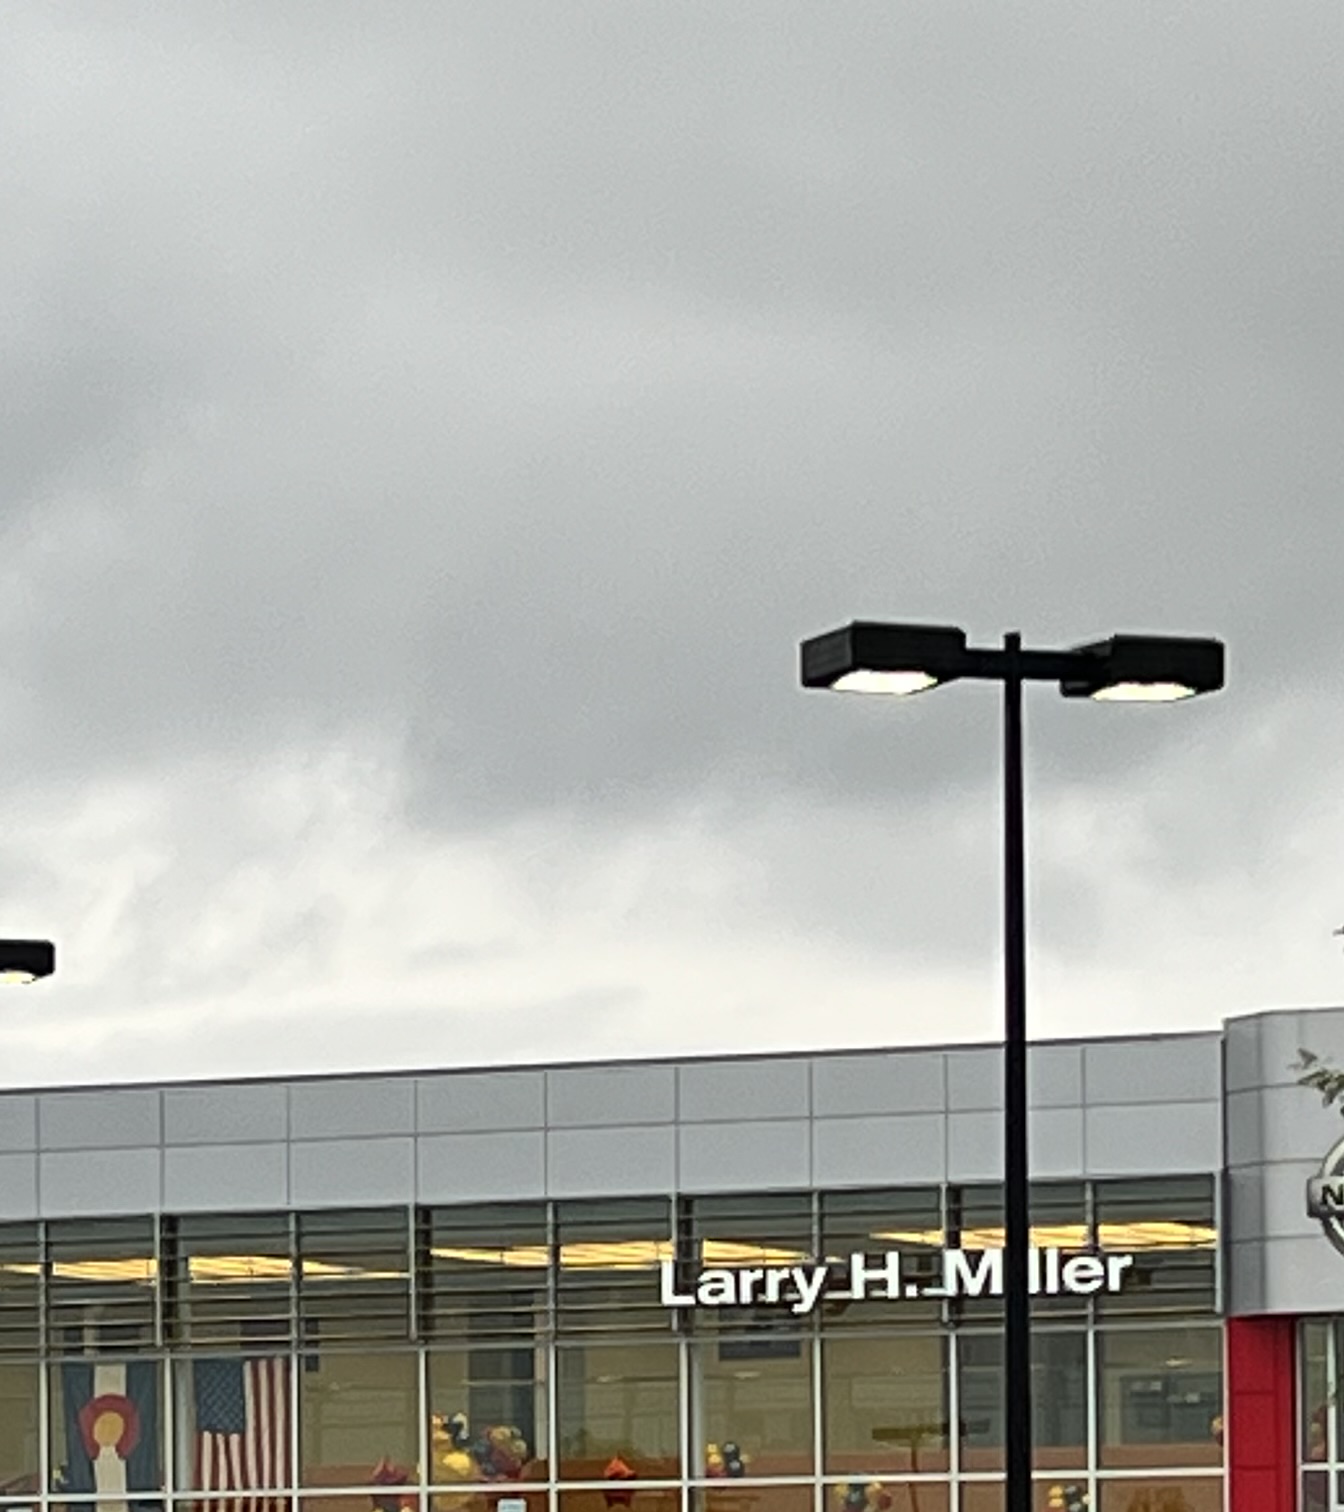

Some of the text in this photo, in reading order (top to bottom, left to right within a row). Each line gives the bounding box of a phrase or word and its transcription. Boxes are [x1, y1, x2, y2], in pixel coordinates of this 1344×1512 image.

[660, 1247, 1134, 1314] Larry H. Mller
